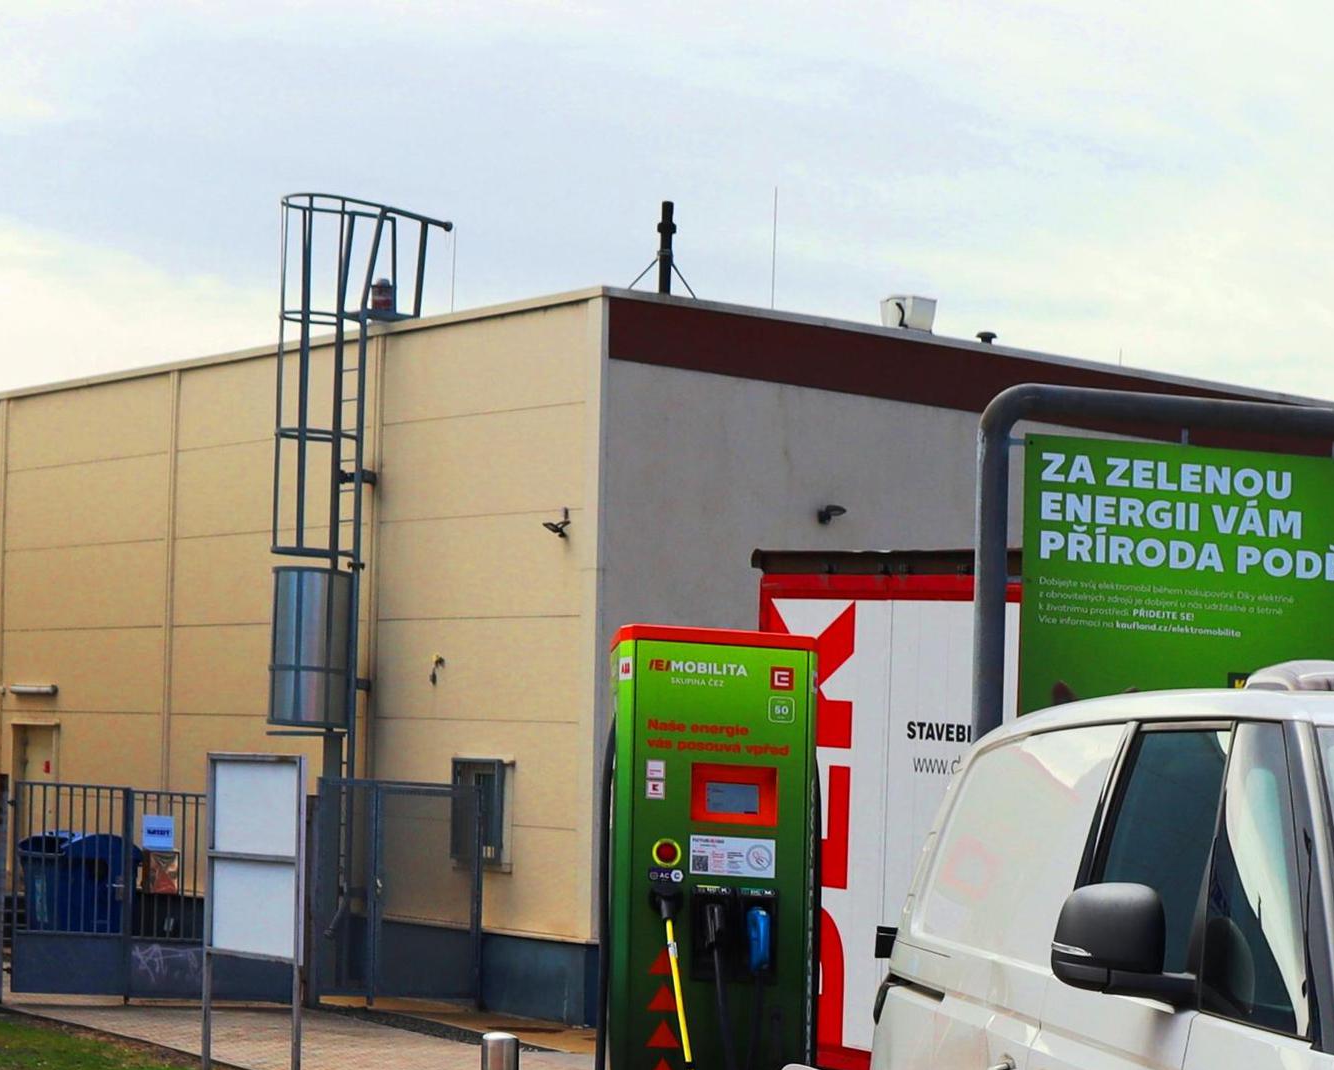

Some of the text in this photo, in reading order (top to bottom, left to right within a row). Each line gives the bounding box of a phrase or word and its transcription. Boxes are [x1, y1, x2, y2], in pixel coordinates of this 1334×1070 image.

[1041, 451, 1292, 500] ZA ZELENOU
[1040, 491, 1302, 540] ENERGII VÁM
[1039, 525, 1225, 572] PŘÍRODA
[691, 723, 749, 738] energie
